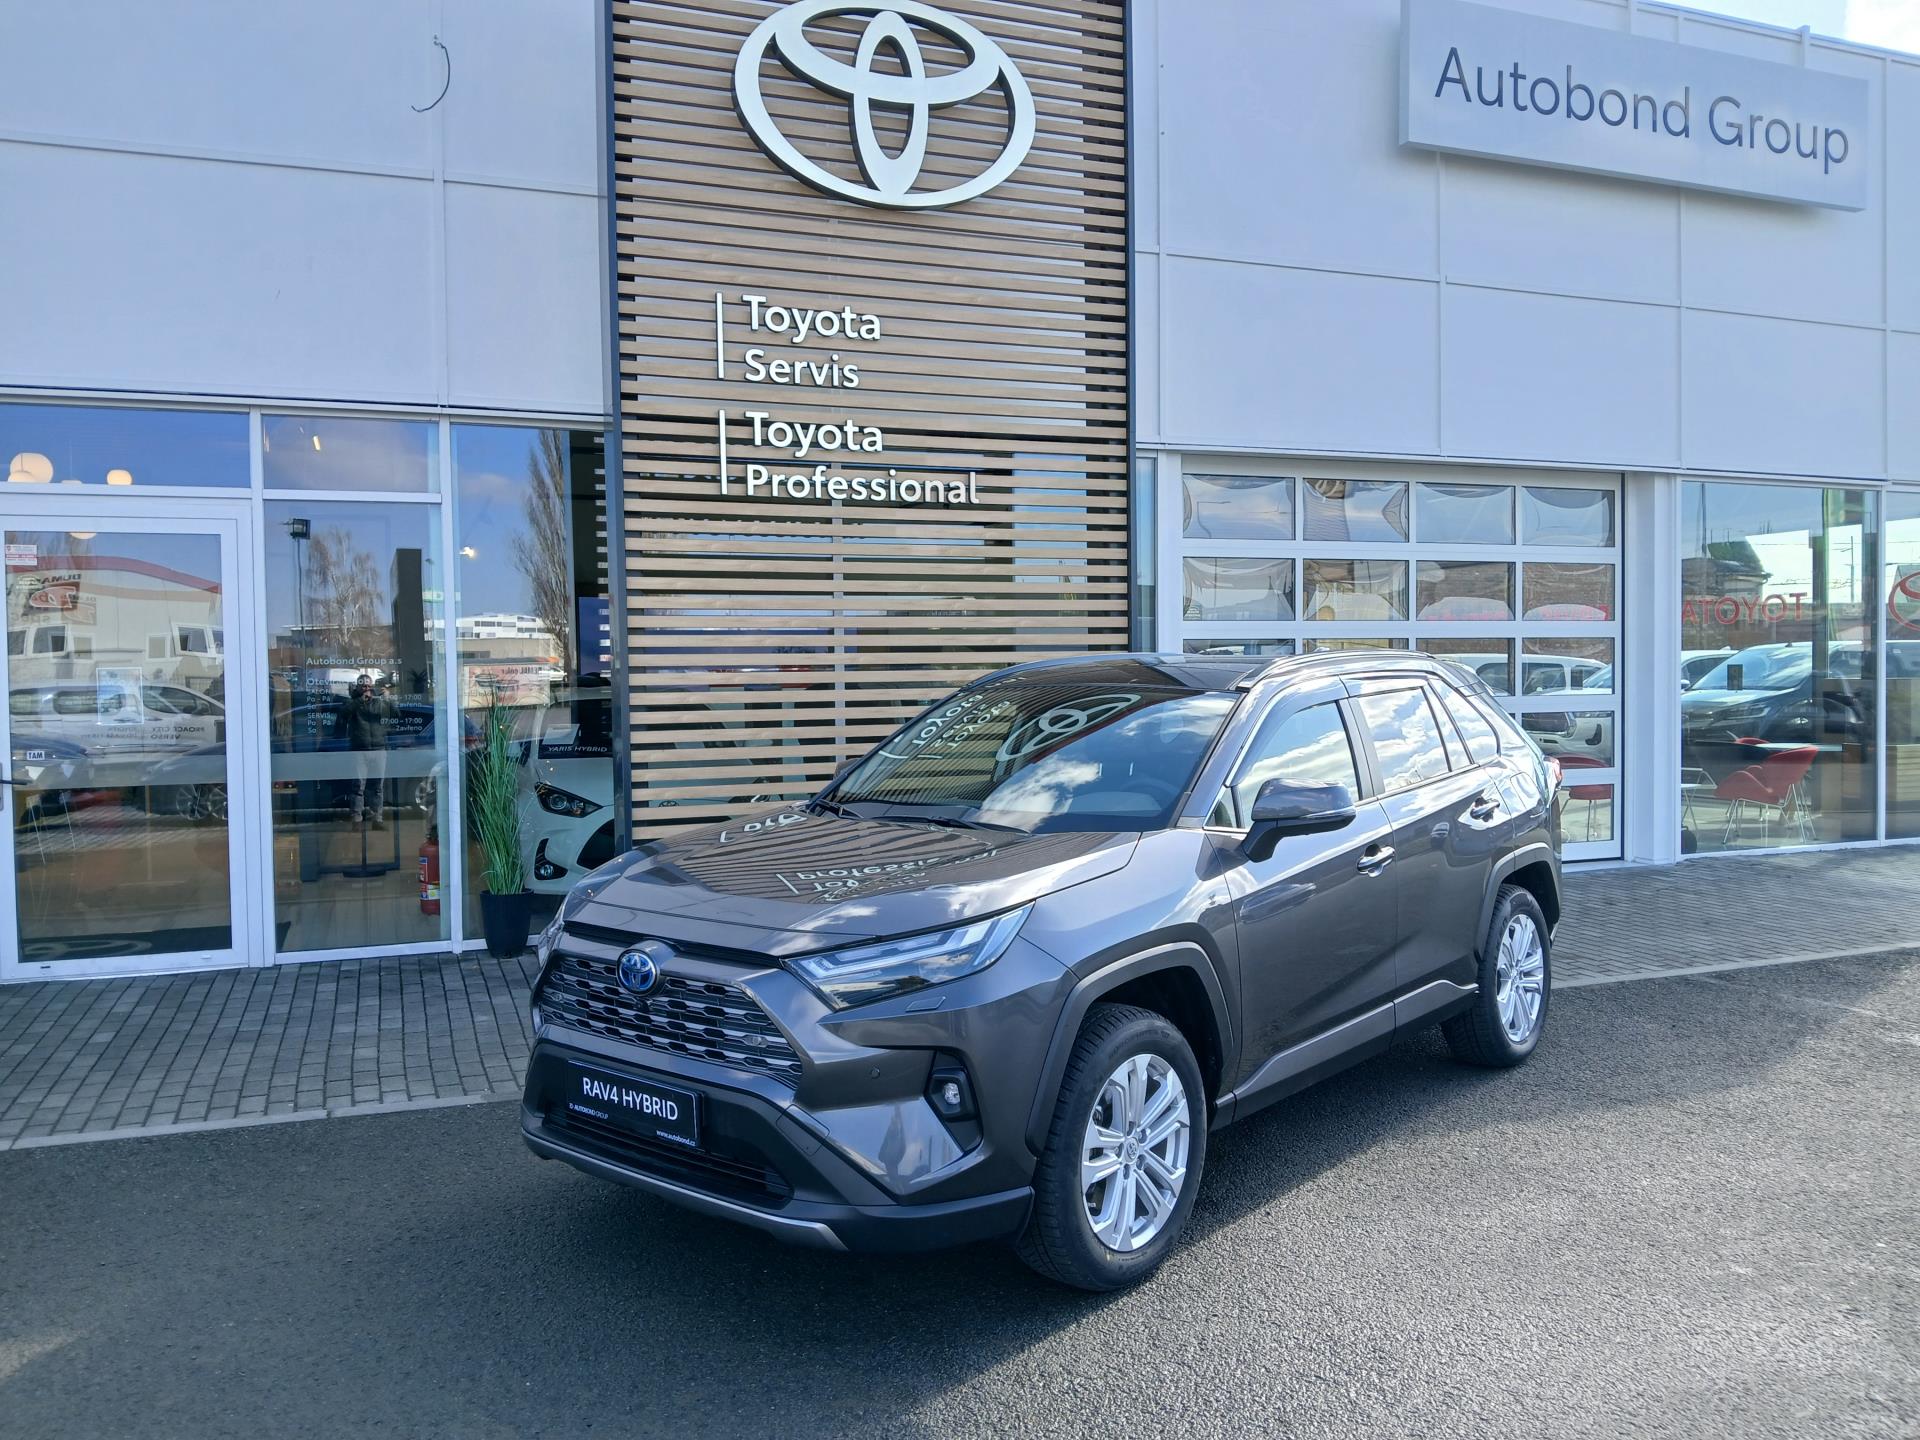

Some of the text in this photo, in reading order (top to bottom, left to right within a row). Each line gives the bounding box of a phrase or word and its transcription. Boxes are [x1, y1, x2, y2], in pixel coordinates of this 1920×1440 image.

[1434, 46, 1850, 175] Autobond Group
[741, 294, 881, 344] Toyota
[744, 348, 860, 388] Servis
[744, 410, 883, 458] Toyota
[746, 463, 980, 504] Professional
[306, 657, 355, 665] Autobond
[356, 657, 387, 666] Group
[28, 751, 44, 760] TAM
[574, 745, 608, 753] HYBRID
[573, 1104, 609, 1120] AUTOBOND GROUP
[582, 1076, 679, 1121] RAV4 HYBRID
[655, 1129, 696, 1147] www.autobond.cz
